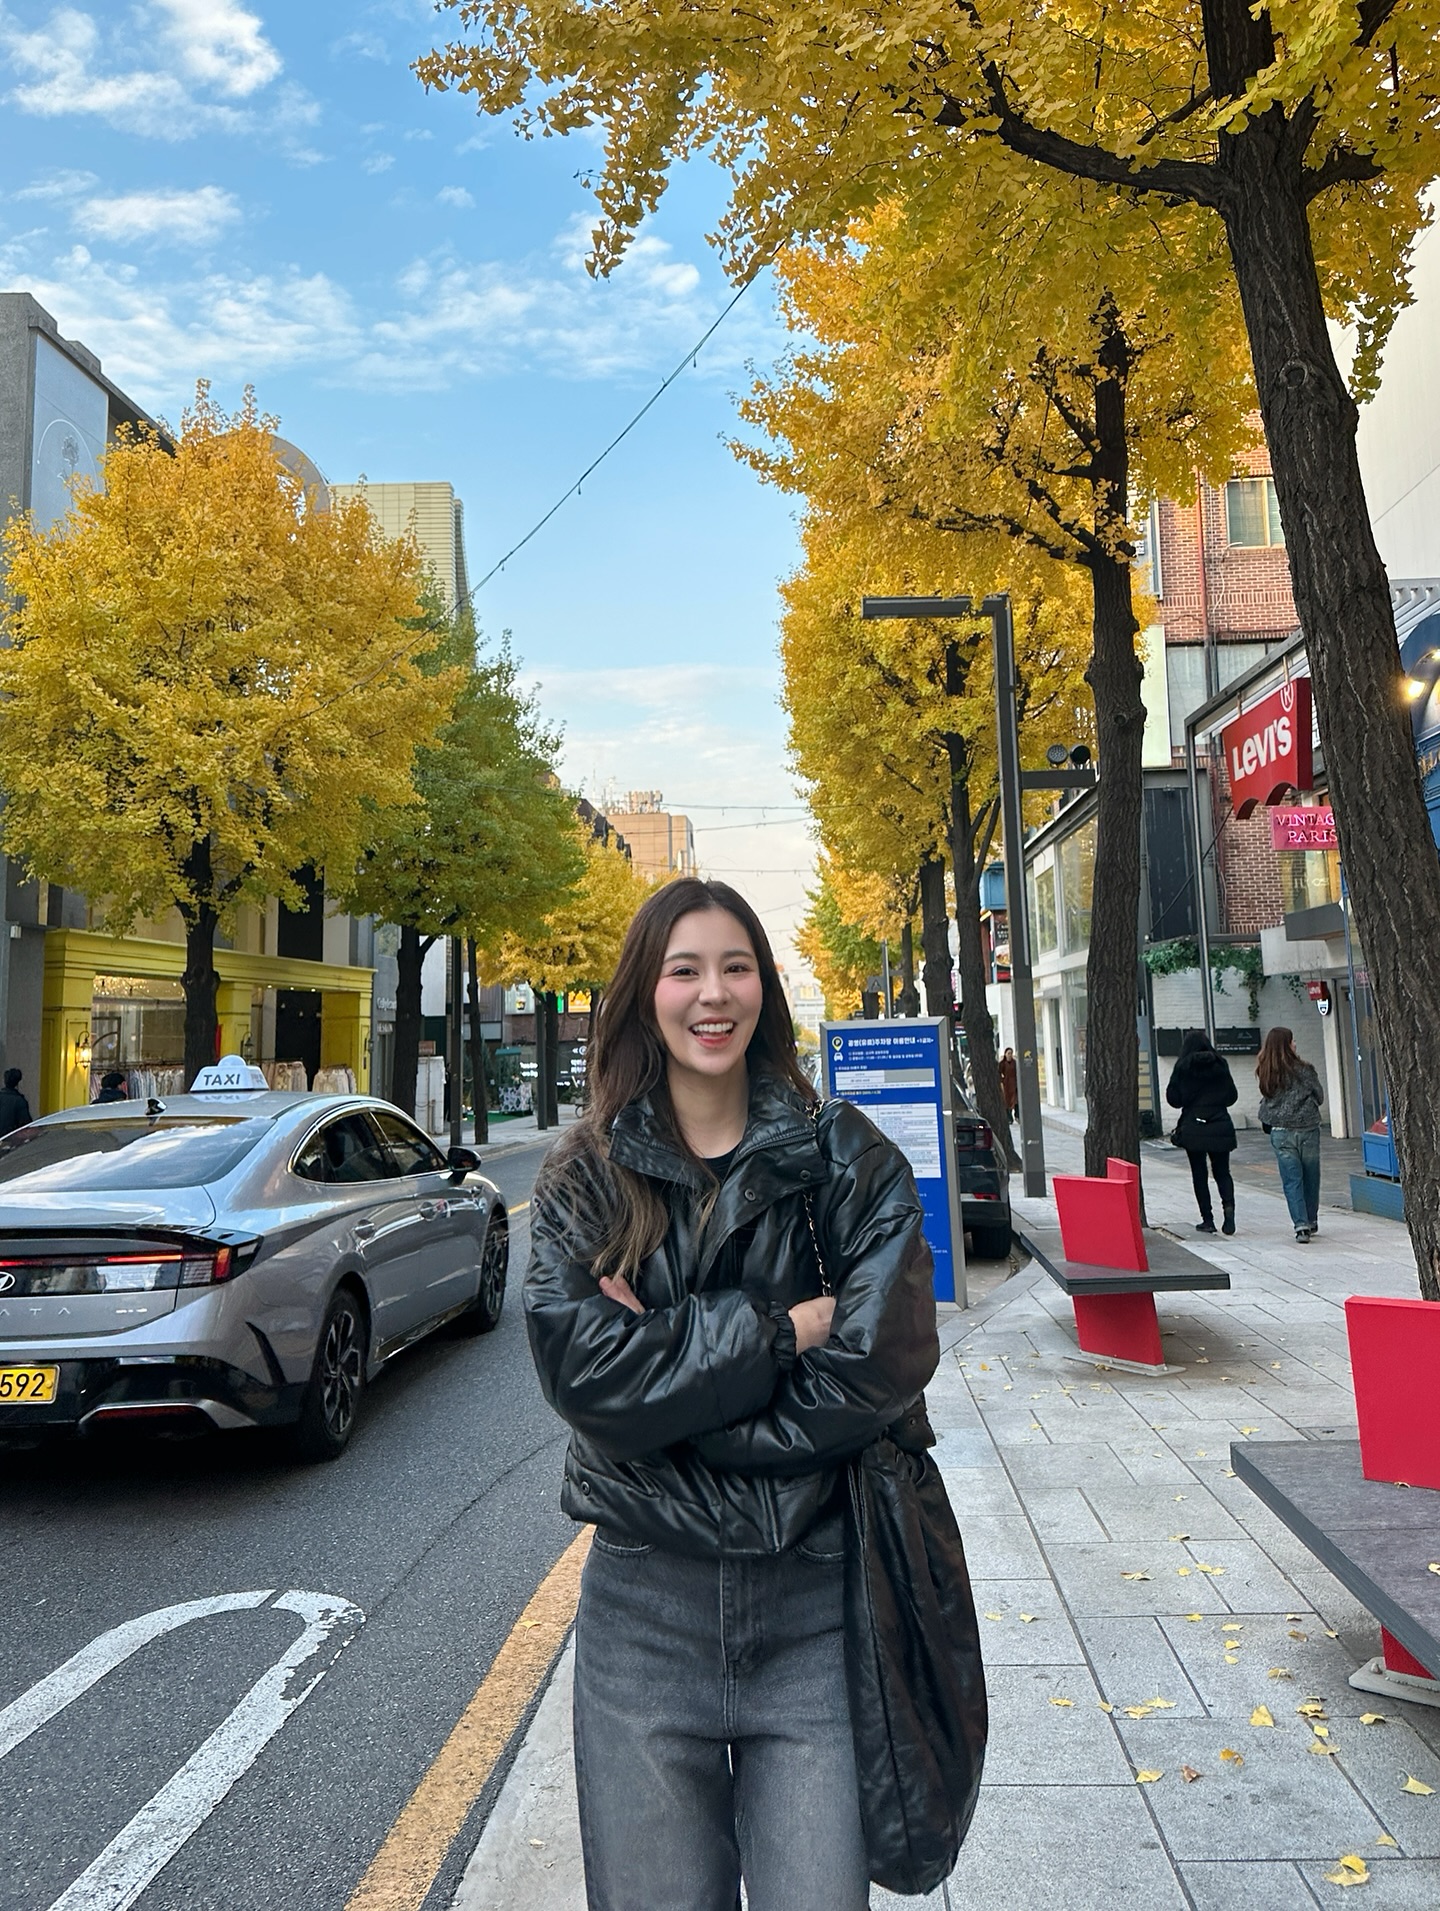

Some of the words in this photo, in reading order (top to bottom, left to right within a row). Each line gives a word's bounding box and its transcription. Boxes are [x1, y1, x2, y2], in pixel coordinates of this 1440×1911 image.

[1275, 813, 1335, 827] VINTAG
[1287, 829, 1338, 843] PARIS
[203, 1074, 241, 1086] TAXI
[0, 1373, 45, 1397] 592
